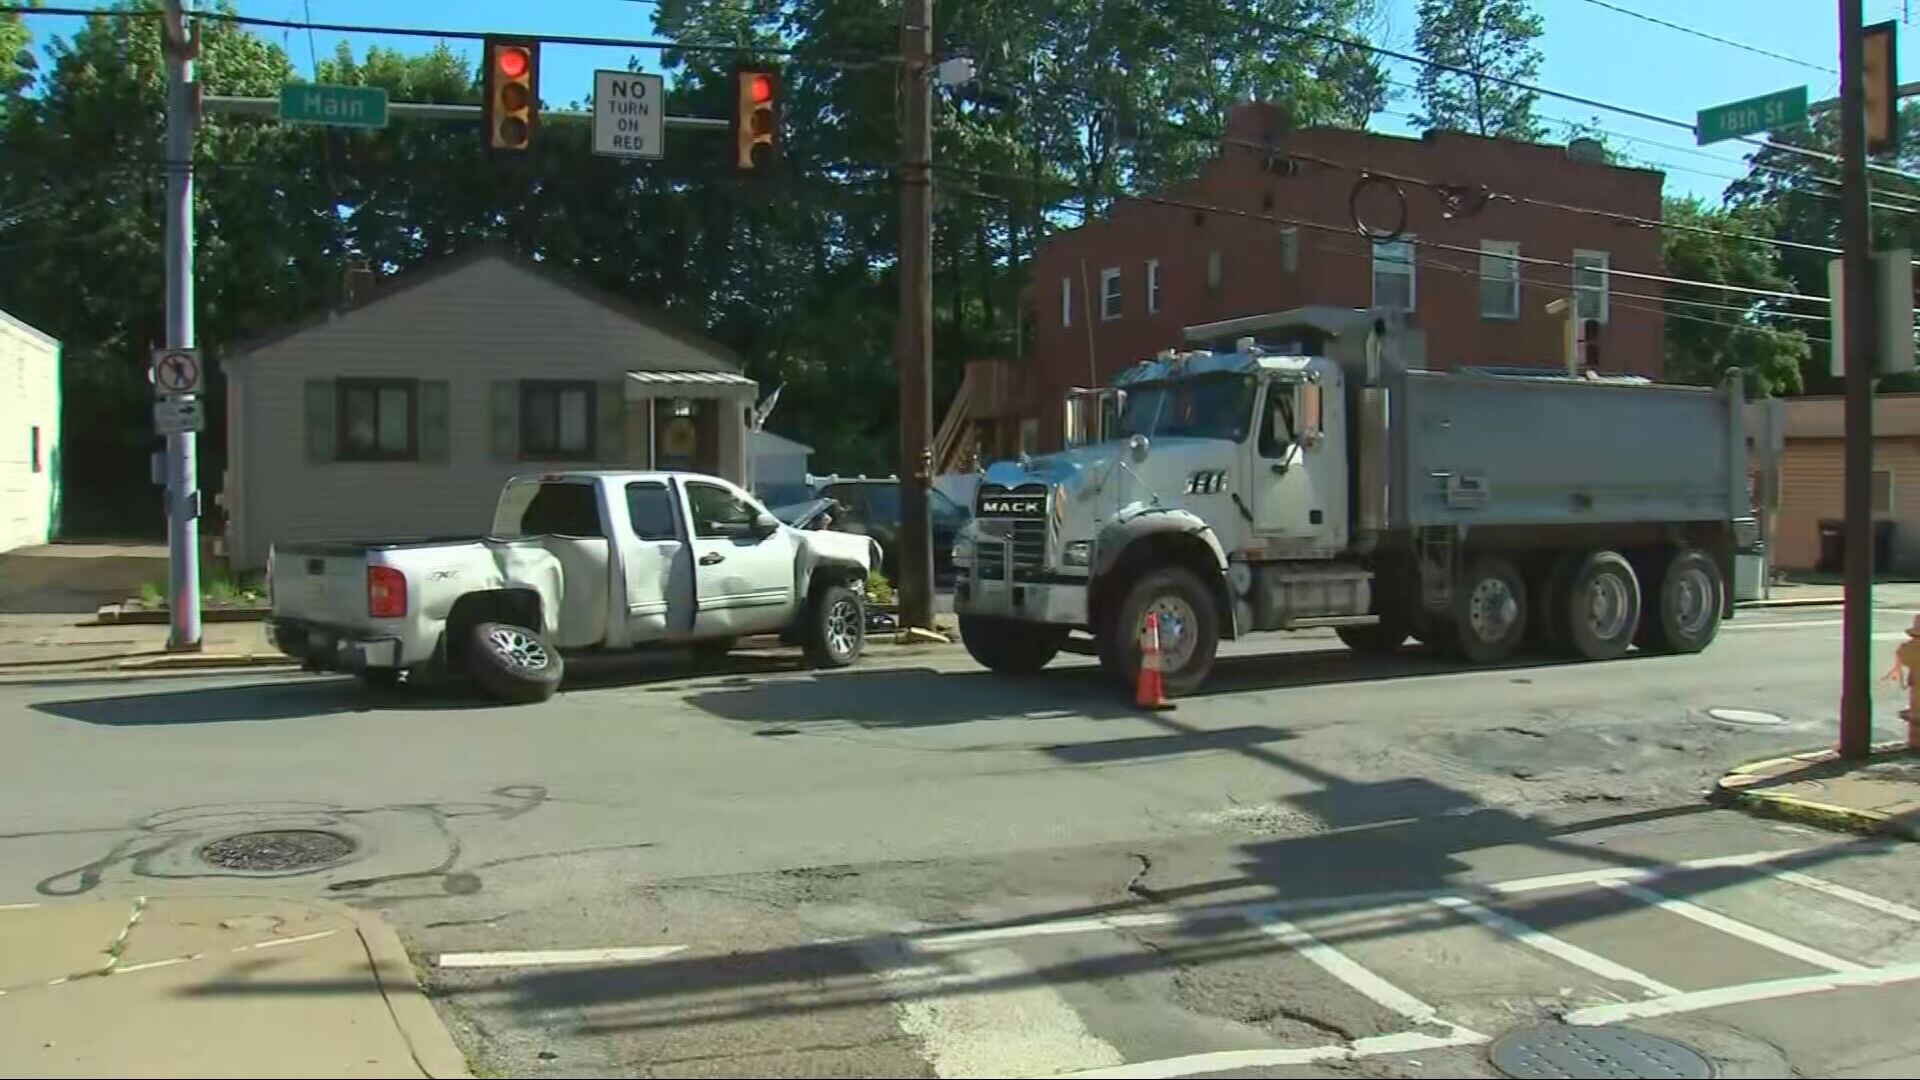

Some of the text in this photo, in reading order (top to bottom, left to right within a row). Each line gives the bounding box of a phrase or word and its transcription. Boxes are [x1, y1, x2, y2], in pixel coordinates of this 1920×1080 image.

[612, 80, 646, 98] NO
[303, 92, 363, 117] Main
[609, 100, 648, 116] TURN
[1720, 99, 1785, 130] 18th St
[618, 118, 639, 132] ON
[613, 135, 644, 150] RED
[983, 502, 1039, 512] MACK
